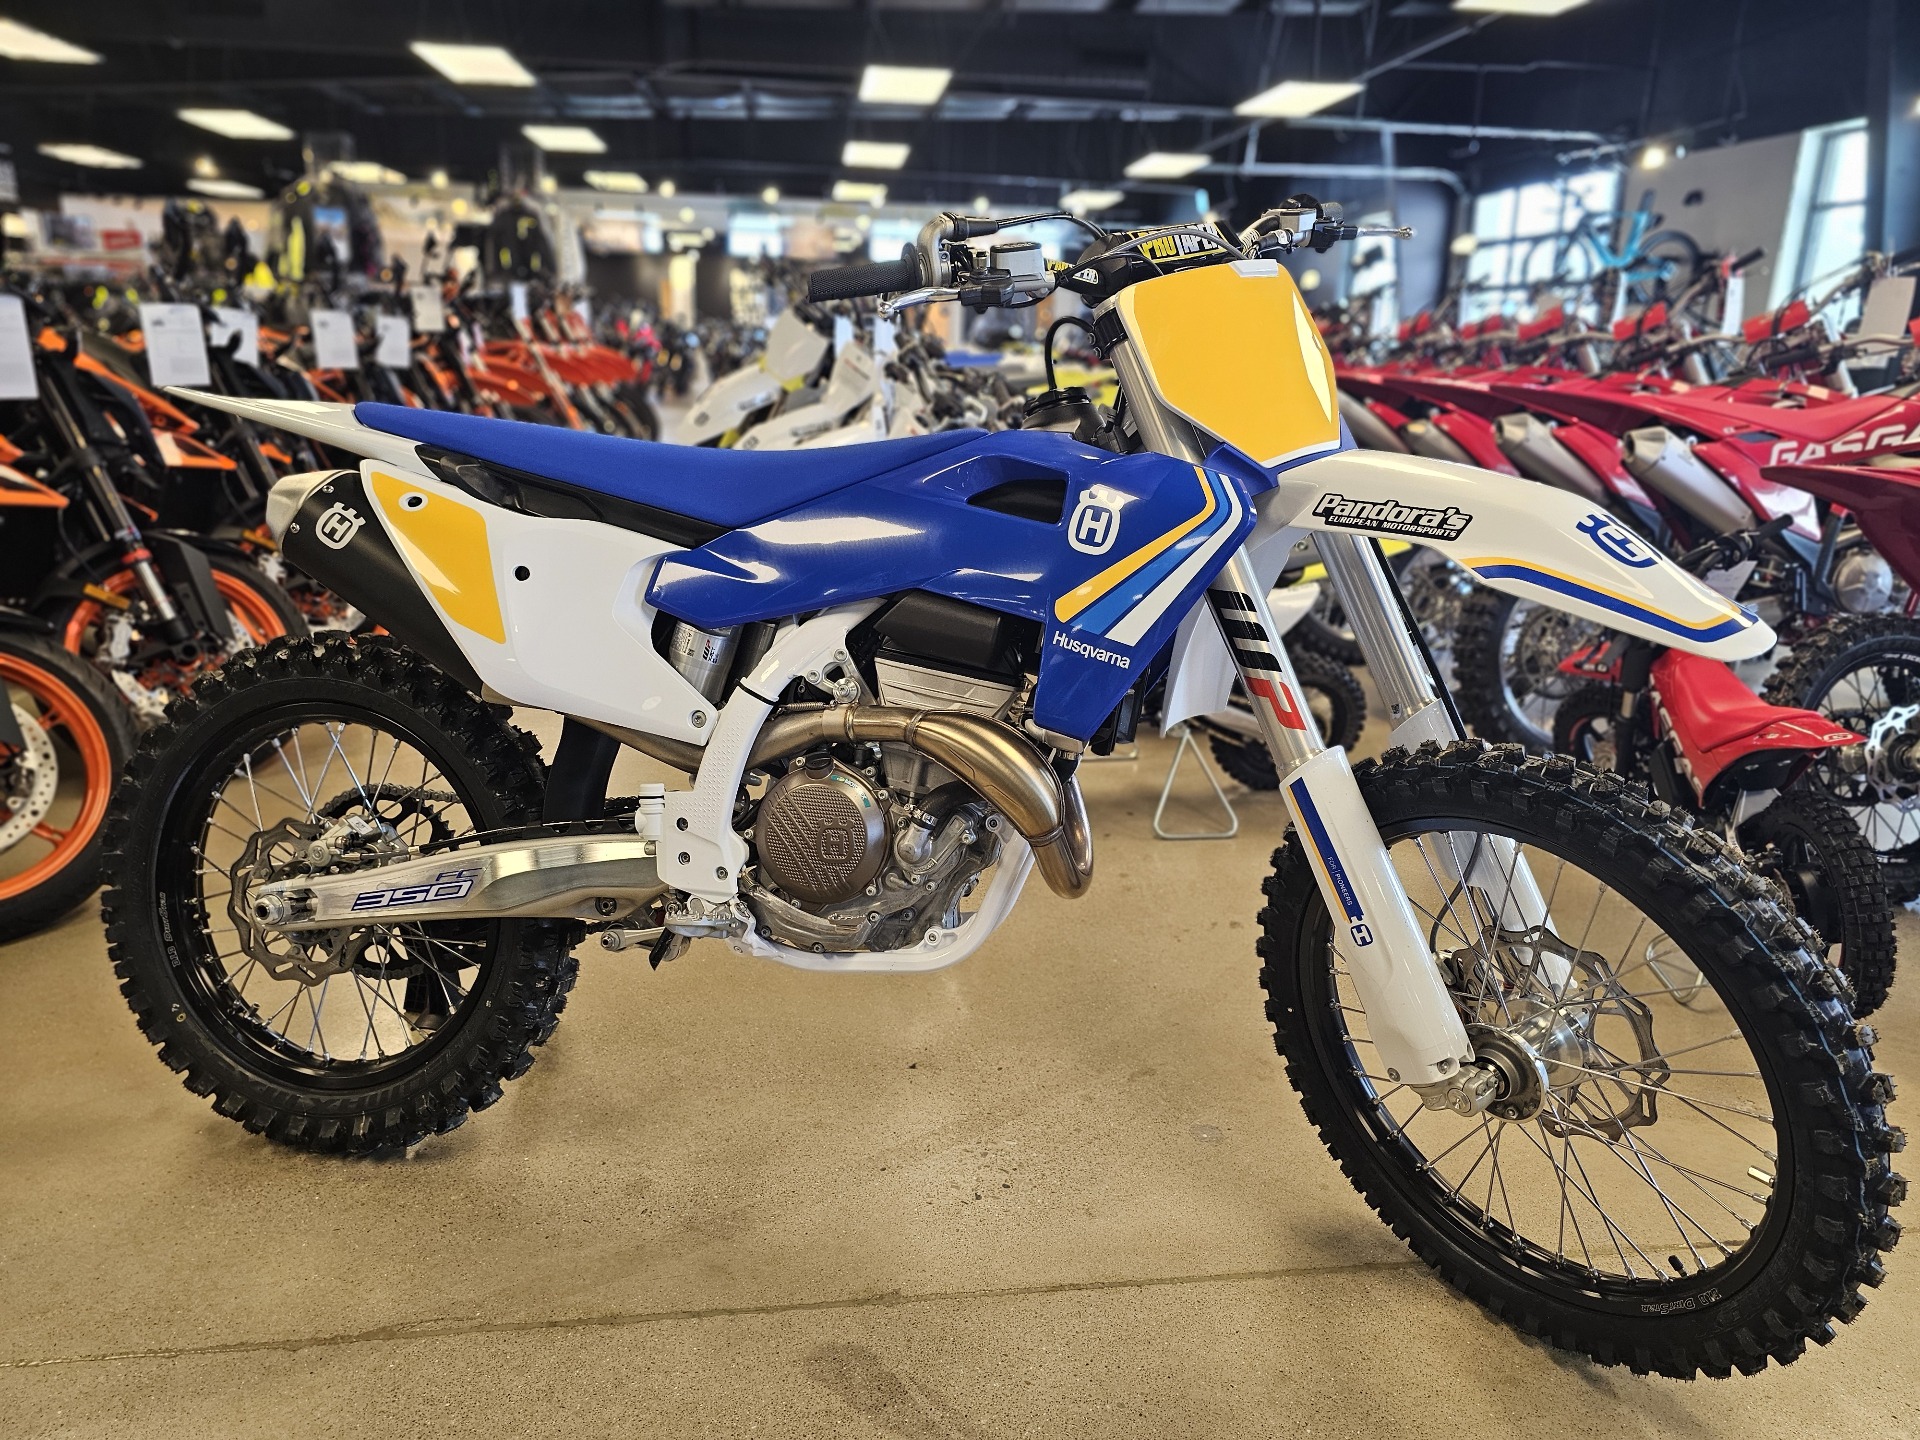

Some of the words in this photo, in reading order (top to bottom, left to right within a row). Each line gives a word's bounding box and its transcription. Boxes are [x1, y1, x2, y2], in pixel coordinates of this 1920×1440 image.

[1315, 494, 1470, 530] Pandora's
[1328, 516, 1379, 527] EUROPEAN
[1381, 521, 1458, 538] MOTORSPORTS
[1052, 630, 1131, 670] Husqvarna
[350, 879, 474, 912] 350
[1327, 856, 1337, 870] FOR
[1334, 873, 1354, 906] PIONEERS
